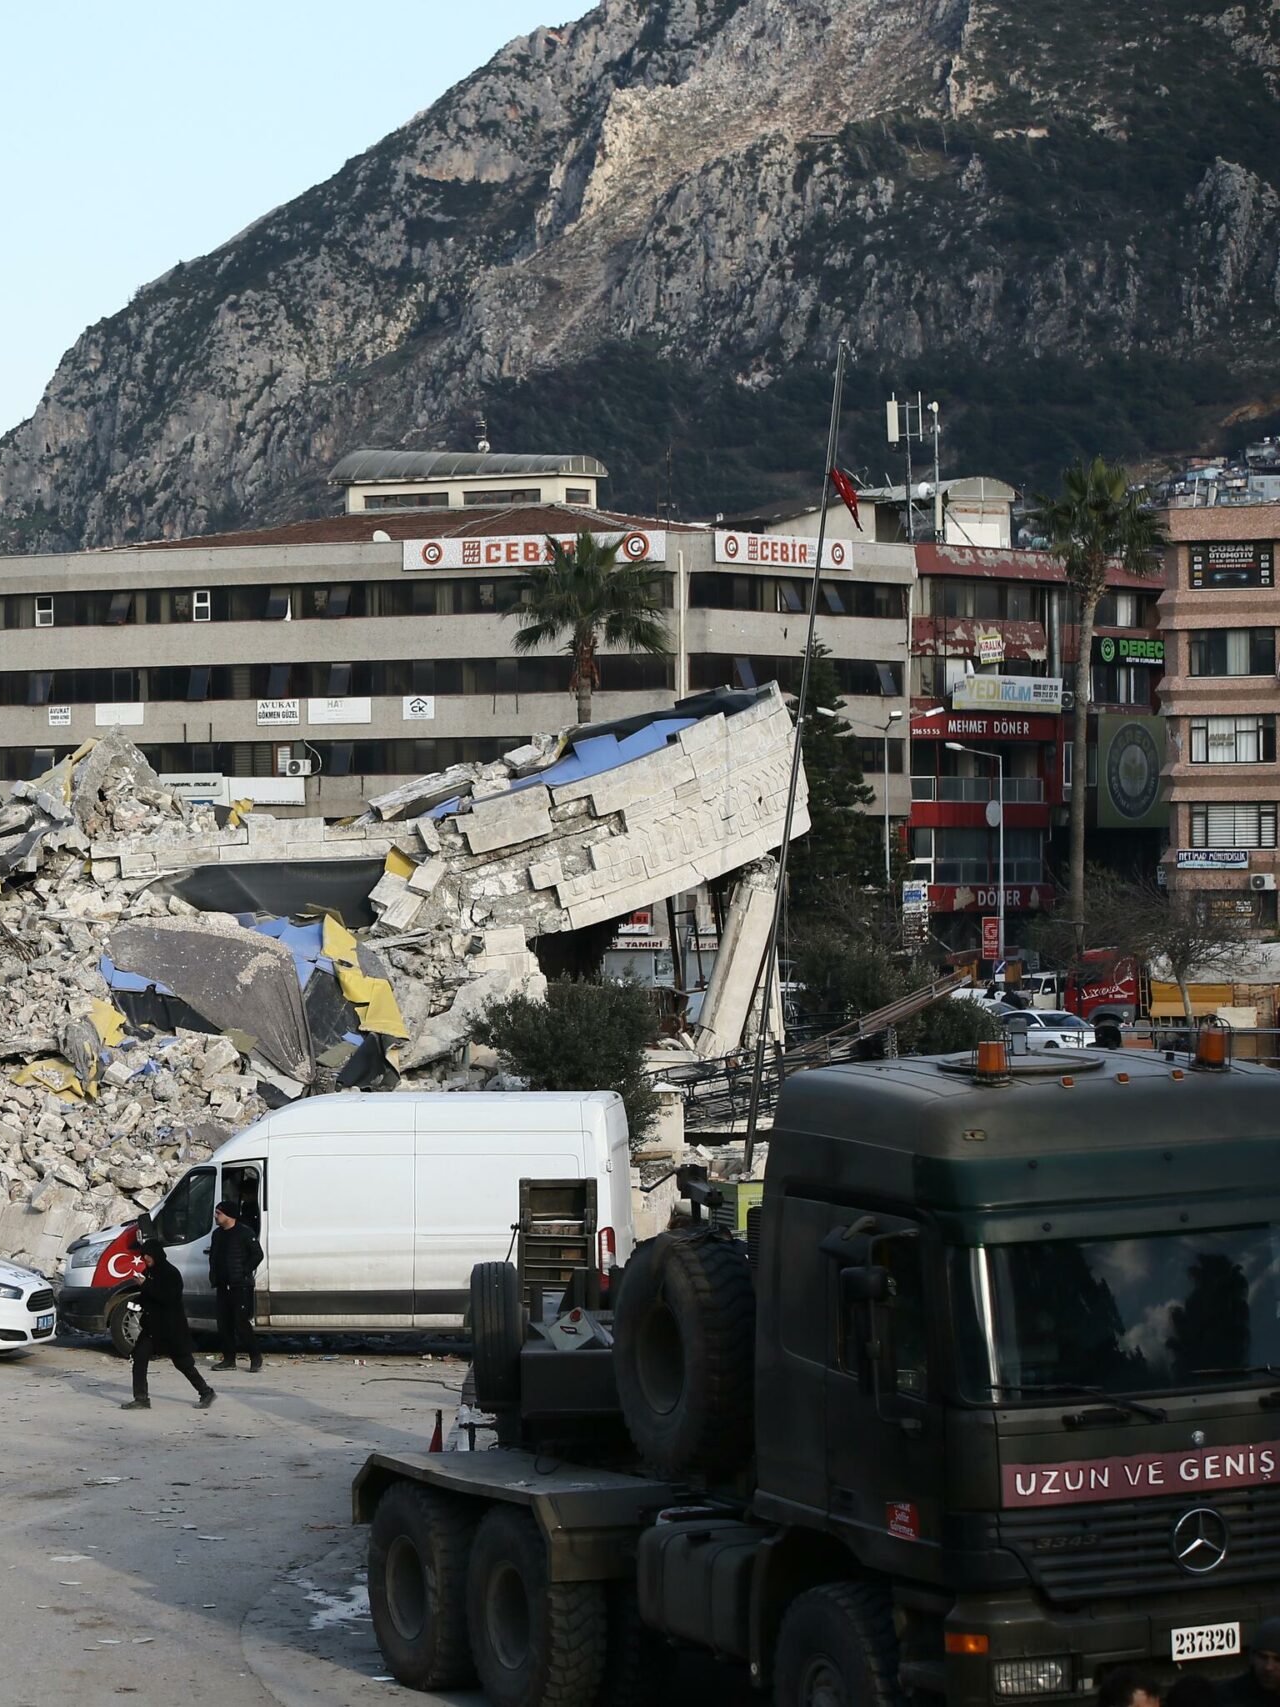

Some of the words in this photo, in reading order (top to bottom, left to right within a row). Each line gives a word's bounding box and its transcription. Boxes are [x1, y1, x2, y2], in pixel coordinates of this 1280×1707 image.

[760, 539, 807, 563] CEBİR
[259, 701, 297, 709] AVUKAT
[258, 710, 280, 719] GÖKMEN
[282, 709, 298, 719] GÜZEL
[948, 720, 987, 734] MEHMET
[994, 718, 1030, 734] DÖNER
[1015, 1466, 1110, 1496] UZUN
[1123, 1461, 1164, 1486] VE
[1179, 1445, 1275, 1481] GENİŞ
[1036, 1534, 1097, 1549] 3343
[1175, 1627, 1236, 1655] 237320
